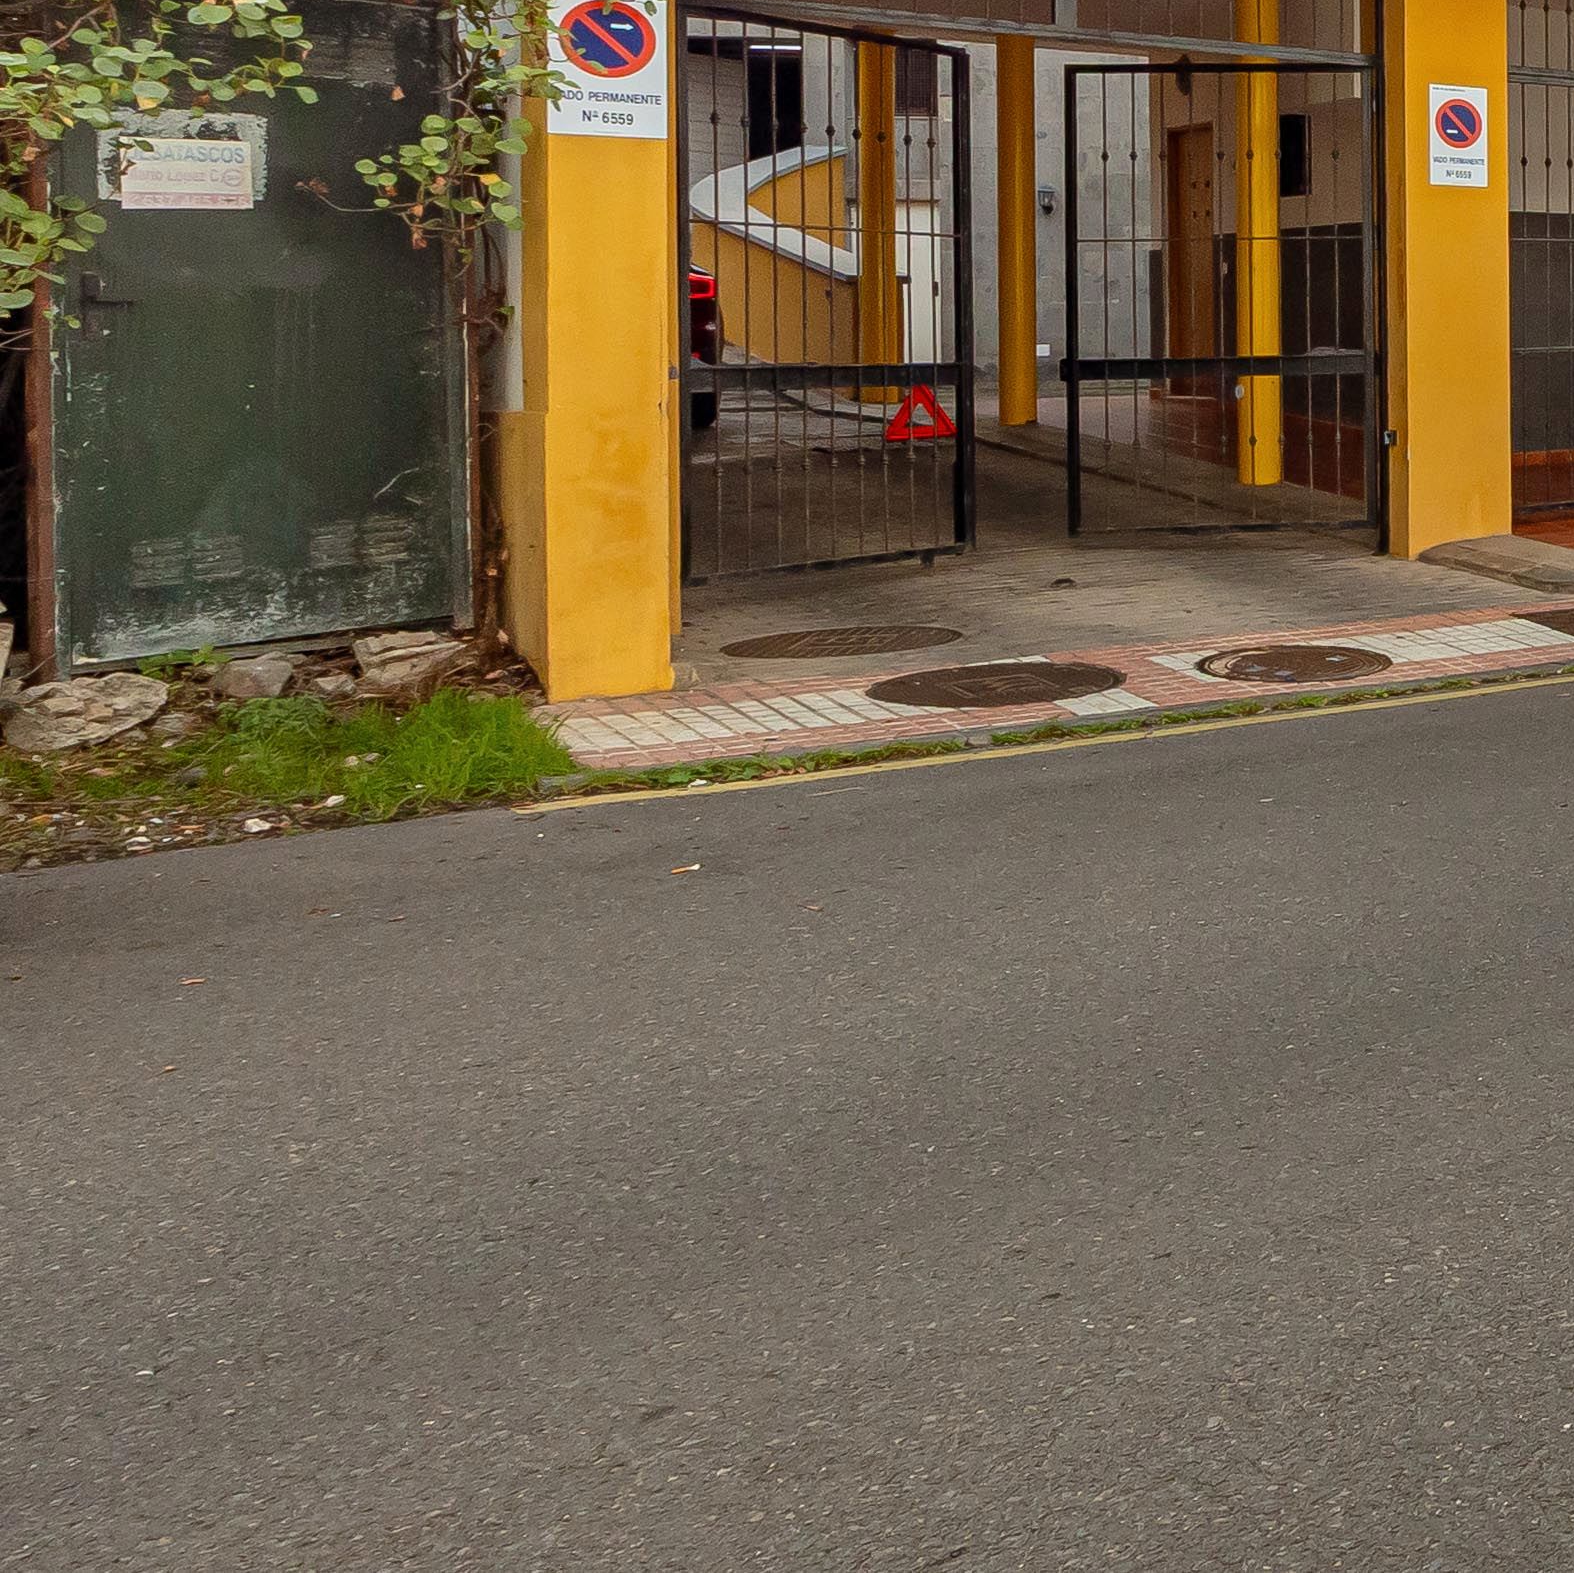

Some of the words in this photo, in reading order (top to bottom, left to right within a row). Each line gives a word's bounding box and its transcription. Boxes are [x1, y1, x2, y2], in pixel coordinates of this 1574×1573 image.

[557, 90, 584, 101] ADO
[588, 91, 662, 106] PERMANENTE
[601, 112, 634, 125] 6559
